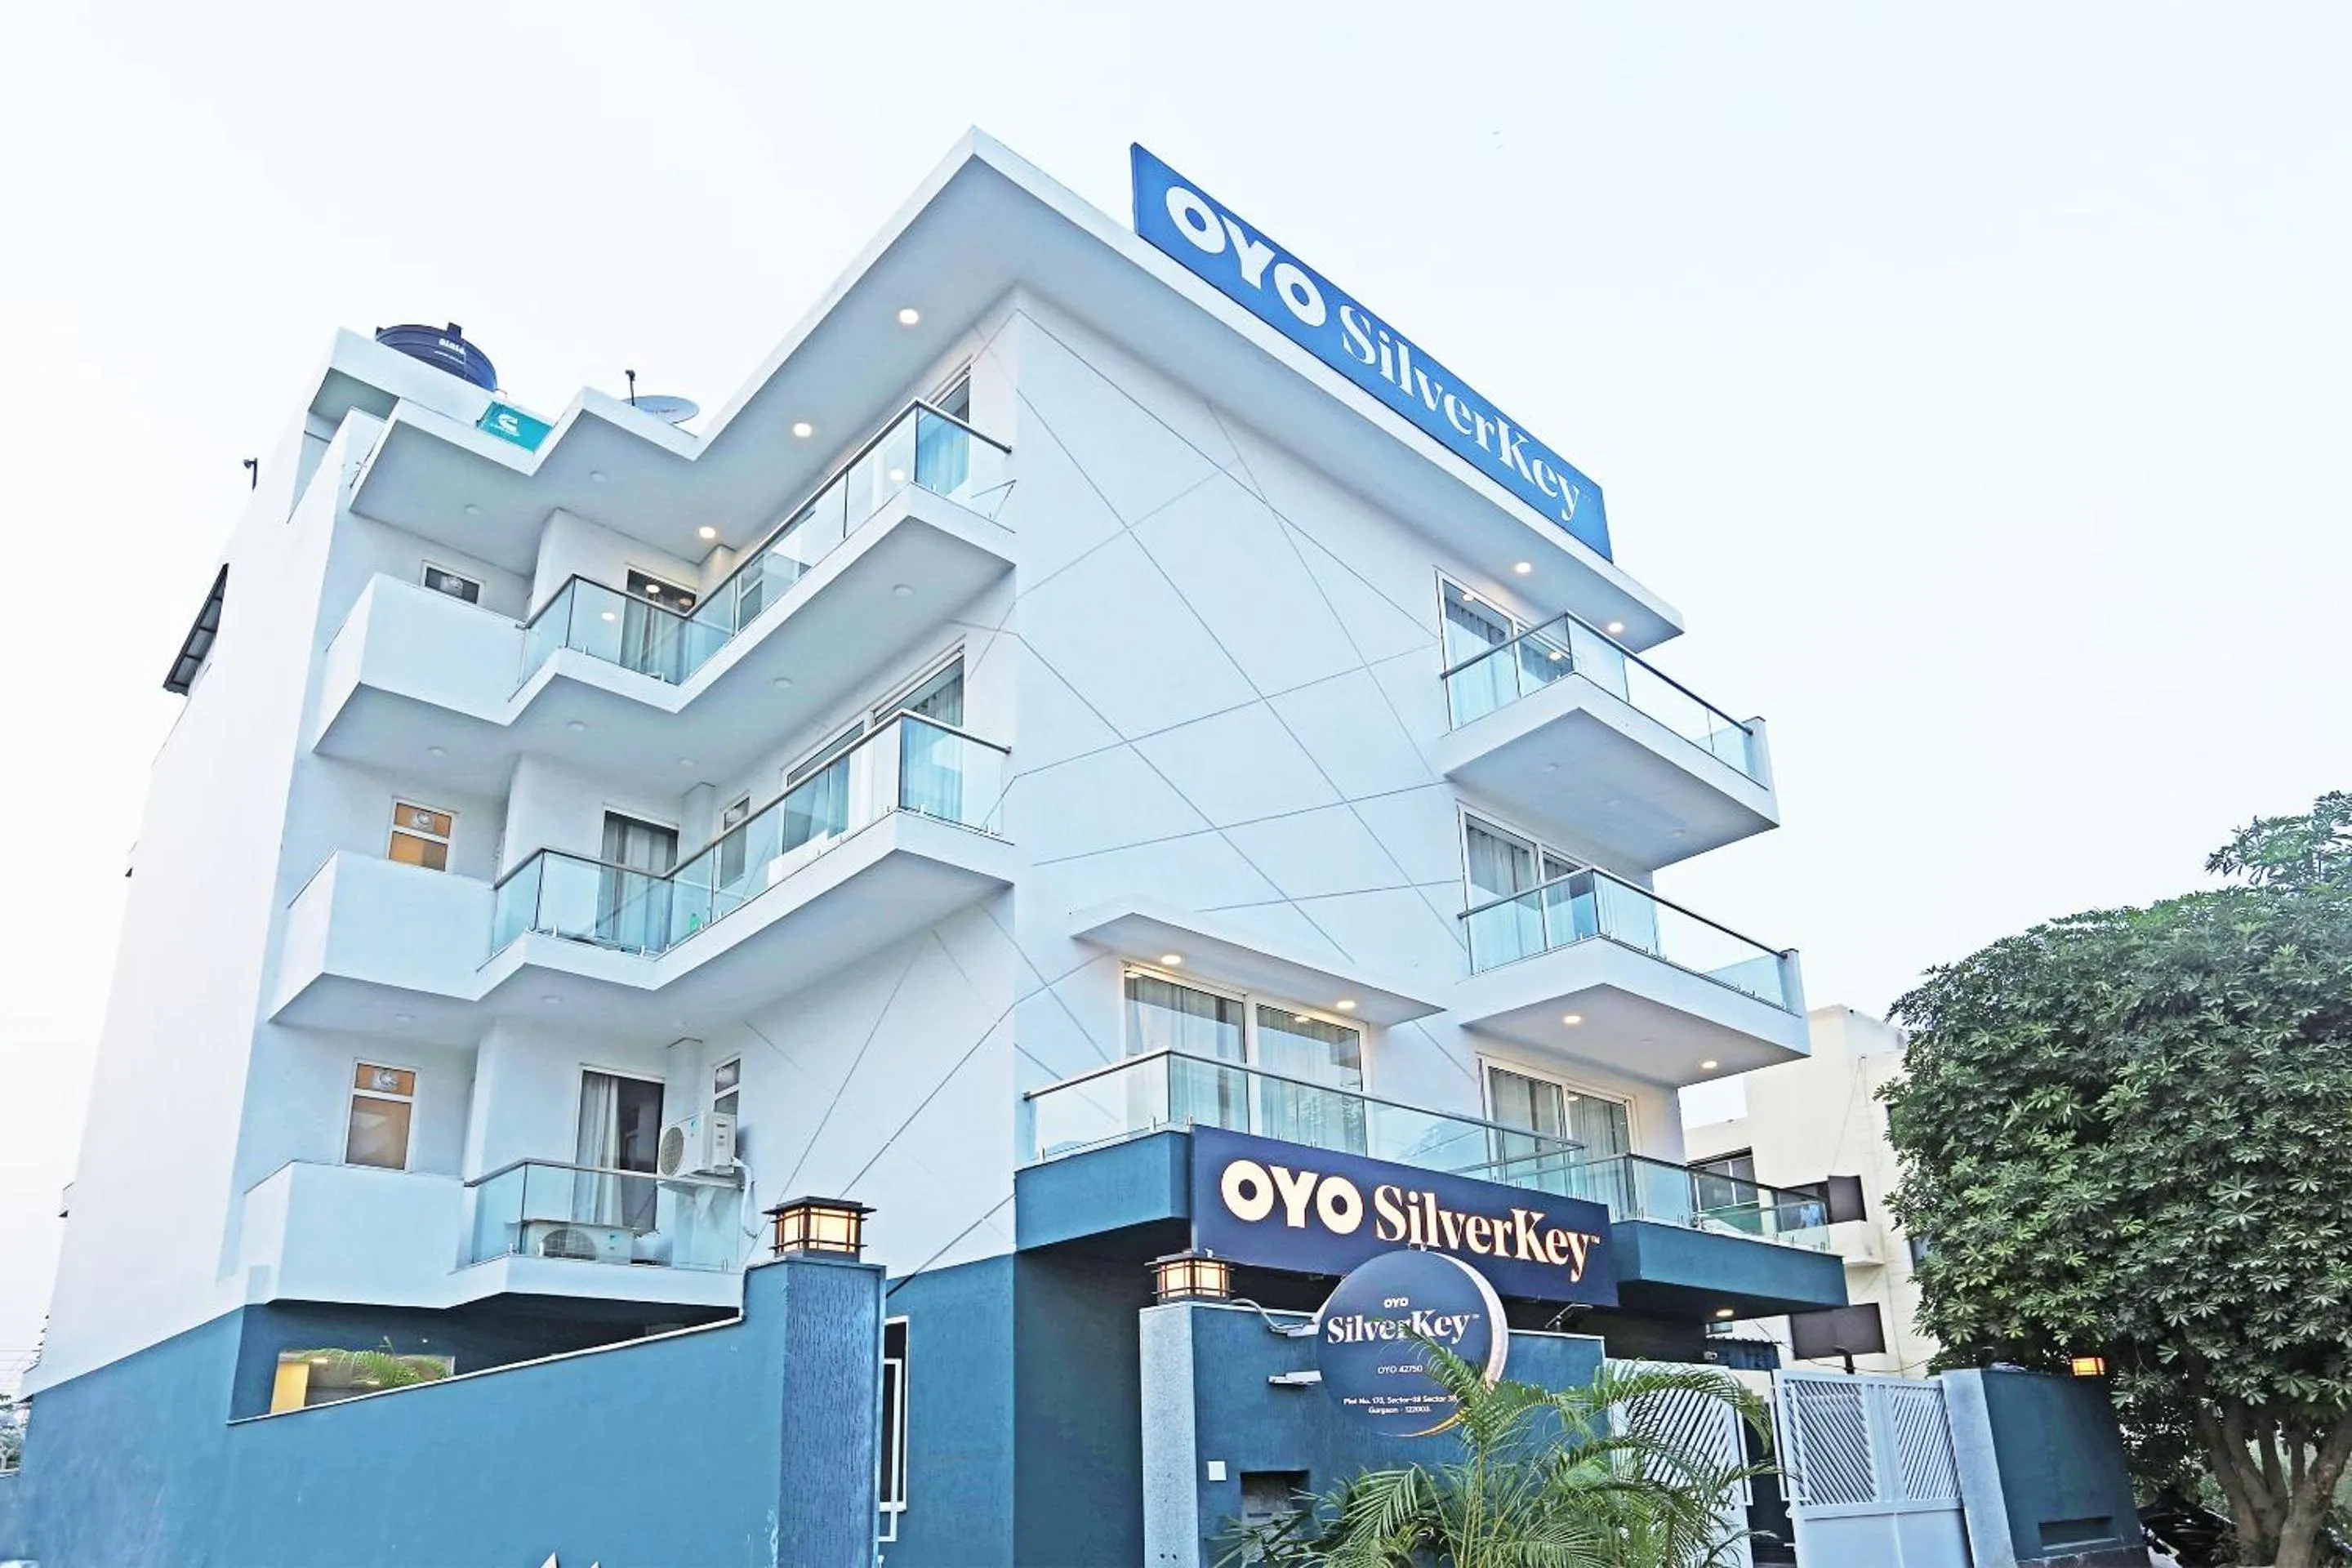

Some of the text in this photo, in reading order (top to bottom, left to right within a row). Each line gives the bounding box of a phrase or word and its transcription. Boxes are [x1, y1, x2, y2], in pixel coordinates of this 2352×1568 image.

[1165, 185, 1580, 521] OYO SilverKey
[1221, 1160, 1364, 1235] OYO
[1383, 1297, 1409, 1308] OYO
